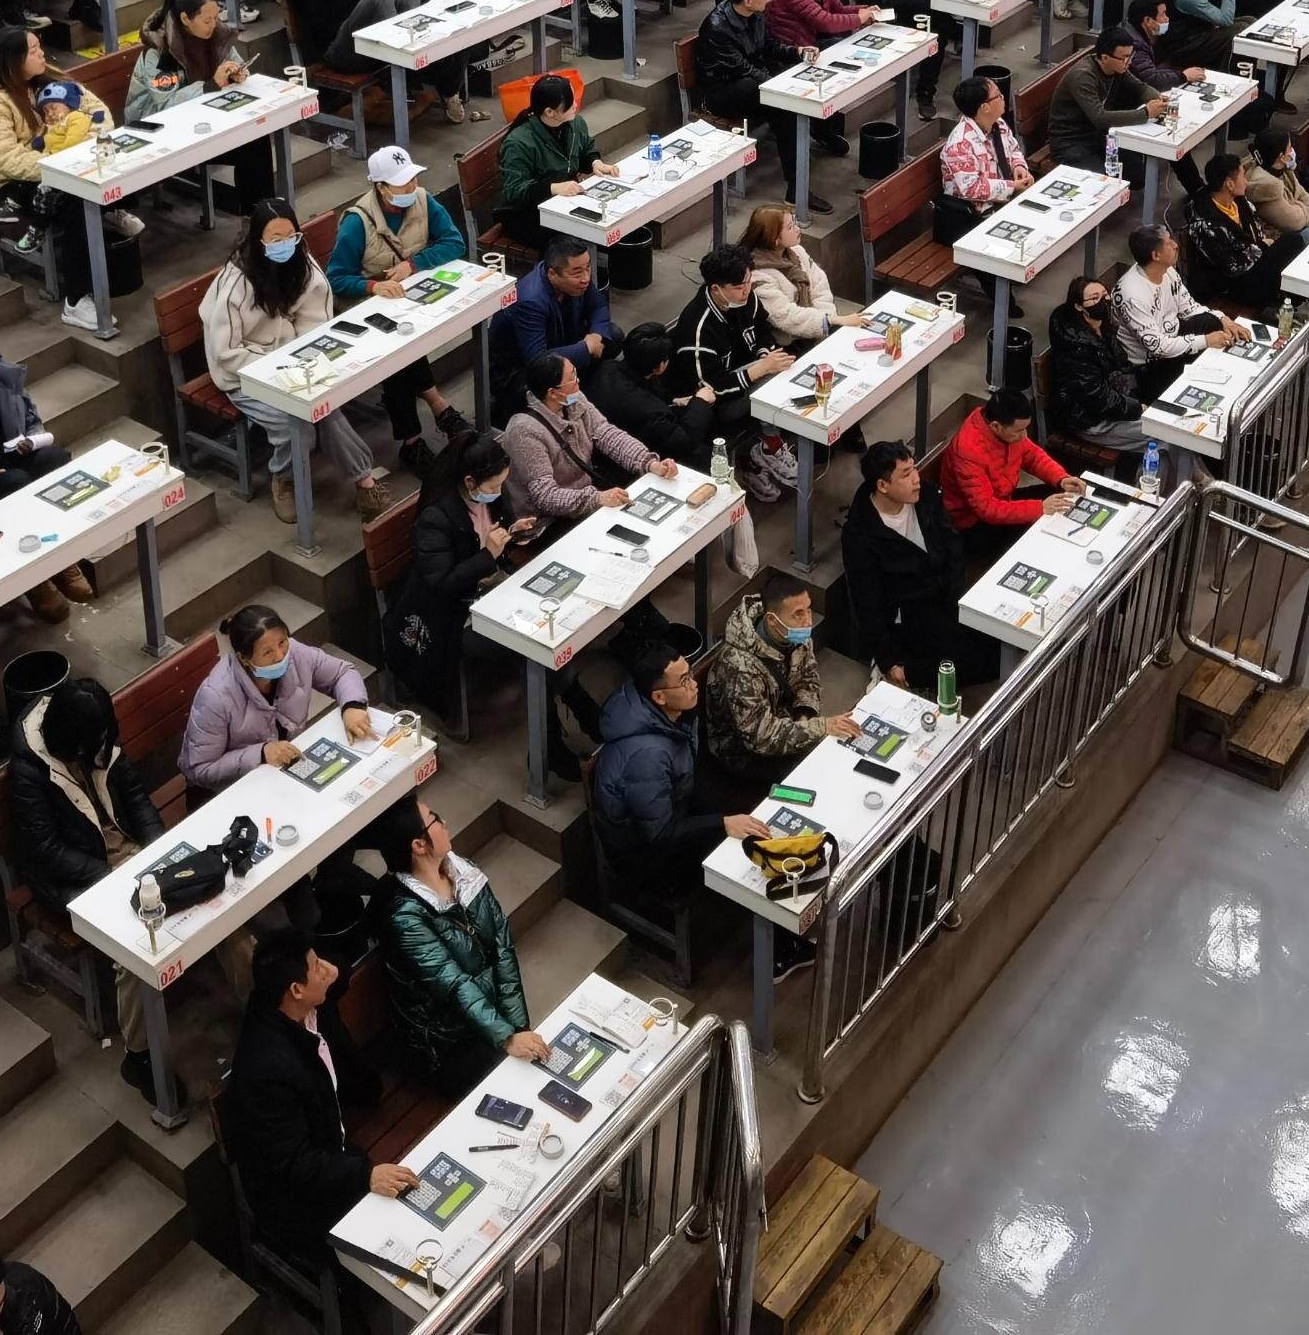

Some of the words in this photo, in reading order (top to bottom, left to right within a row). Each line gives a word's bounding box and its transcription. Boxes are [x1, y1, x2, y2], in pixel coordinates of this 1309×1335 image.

[415, 54, 428, 69] 061
[104, 187, 122, 204] 043
[501, 287, 517, 308] 042
[312, 401, 330, 422] 041
[164, 486, 186, 508] 024
[555, 646, 572, 667] 039
[416, 757, 436, 780] 022
[159, 960, 184, 986] 021
